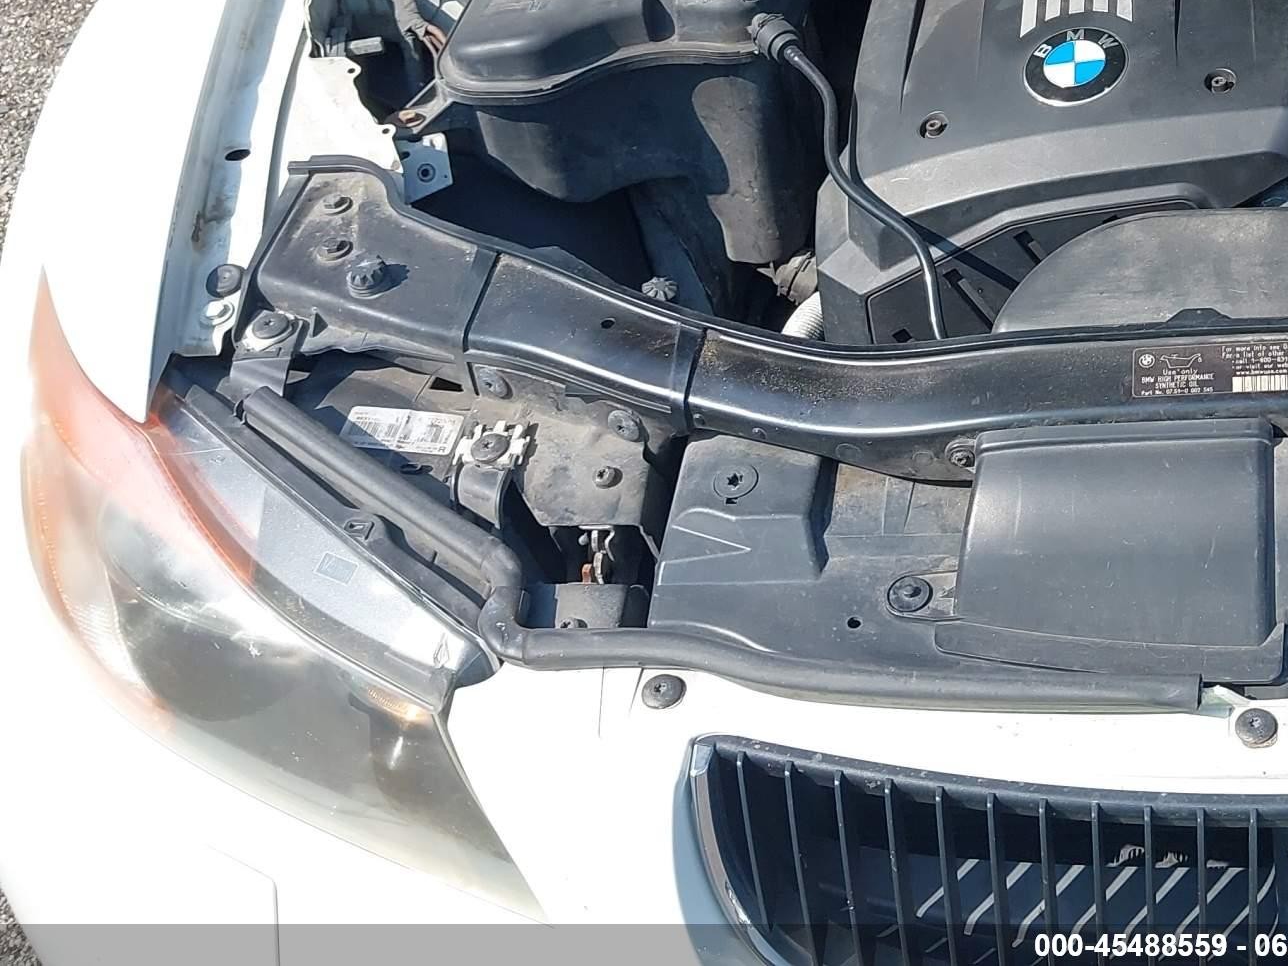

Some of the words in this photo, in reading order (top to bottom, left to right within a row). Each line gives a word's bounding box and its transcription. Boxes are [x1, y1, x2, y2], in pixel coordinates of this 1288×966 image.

[1033, 28, 1119, 59] BMW
[1180, 367, 1198, 375] only
[1141, 376, 1155, 384] BMW
[1173, 373, 1214, 381] PERFORMANCE
[1155, 381, 1187, 389] SYNTHETIC
